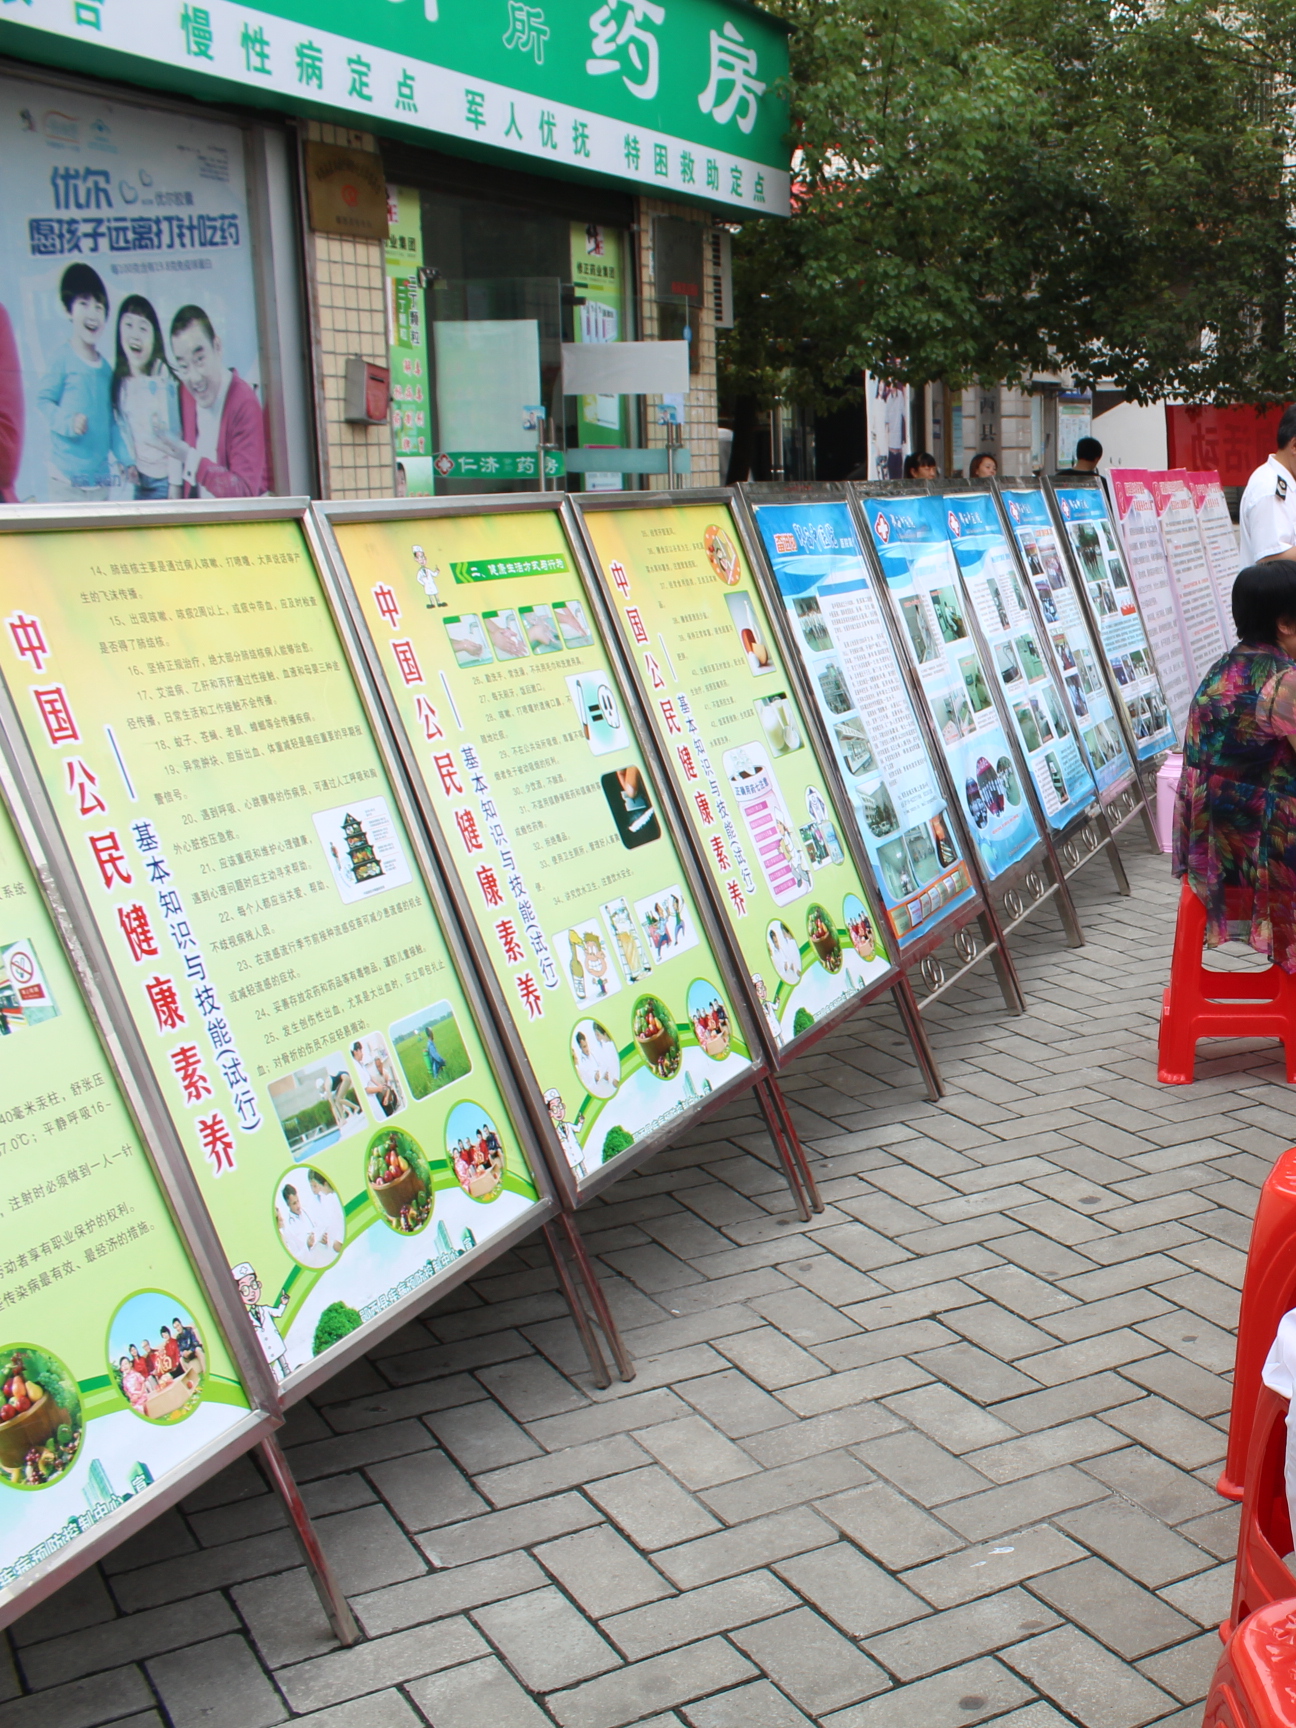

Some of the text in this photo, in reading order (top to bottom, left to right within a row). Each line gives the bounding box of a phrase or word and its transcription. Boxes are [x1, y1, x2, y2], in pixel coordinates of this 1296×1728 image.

[180, 3, 418, 113] 慢性病定点
[464, 88, 590, 158] 军人优抚
[623, 134, 766, 203] 特困救助定点
[586, 0, 767, 135] 药房
[29, 213, 240, 256] 愿孩子远离打针吃药
[51, 166, 114, 210] 优尔
[386, 235, 417, 252] 业集团
[576, 261, 616, 280] 修正药业集团
[373, 584, 543, 1021] 中国公民健康素养
[611, 561, 747, 919] 中国公民健康素养
[9, 614, 236, 1175] 中国公民健康素养
